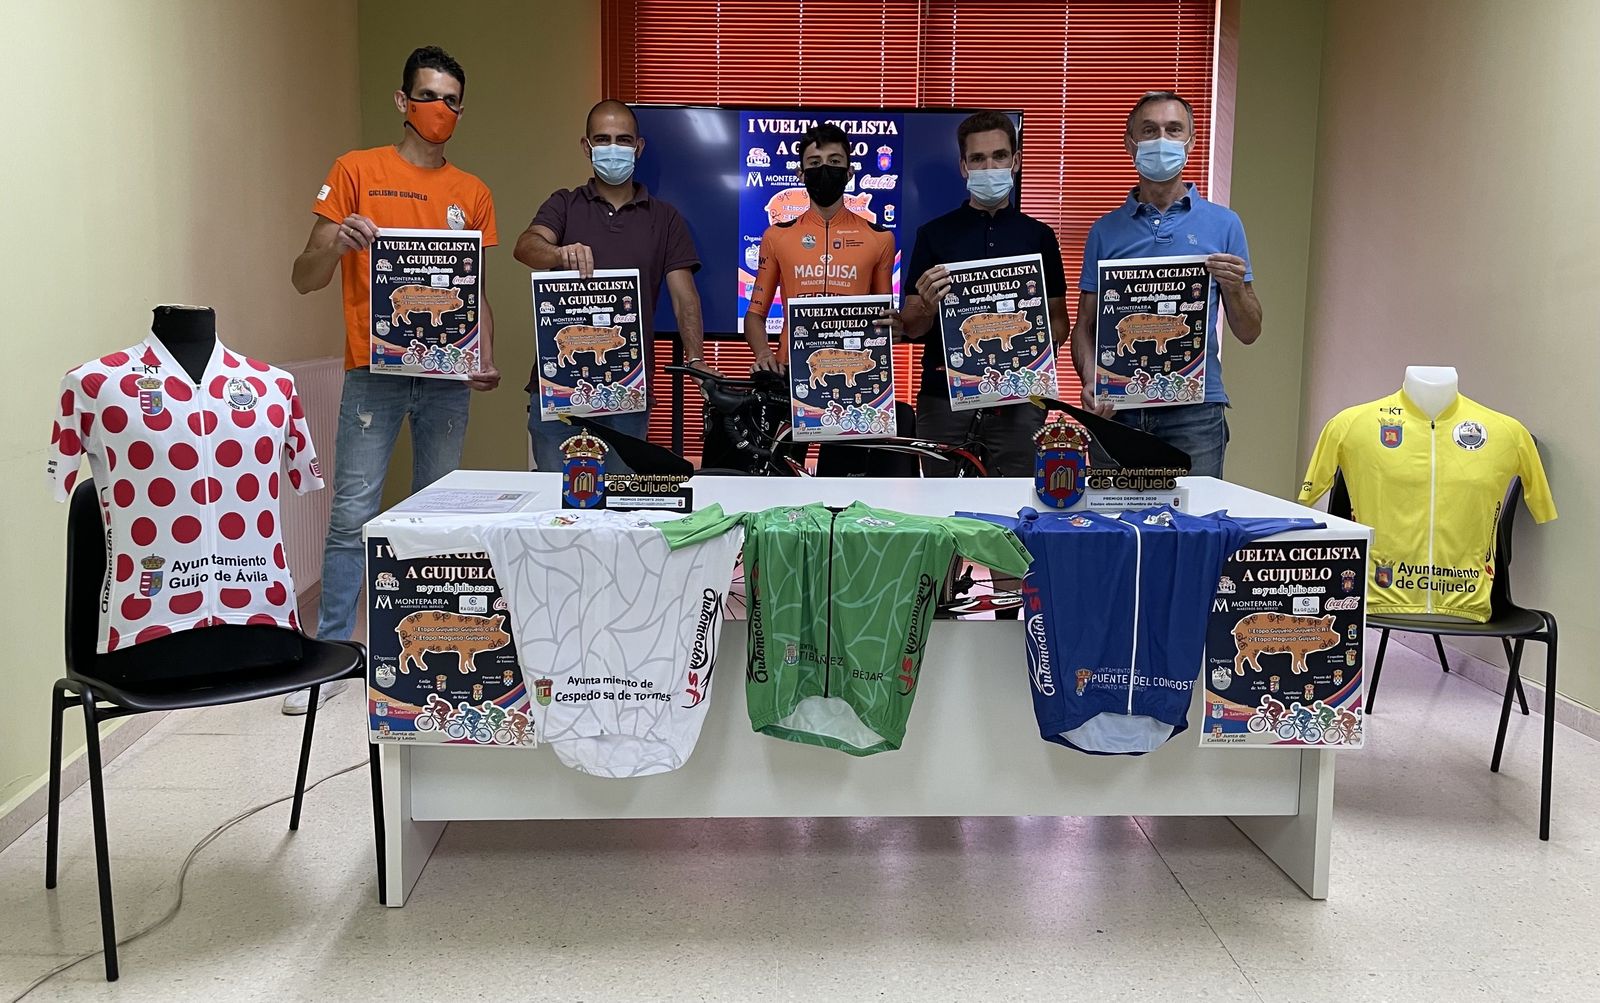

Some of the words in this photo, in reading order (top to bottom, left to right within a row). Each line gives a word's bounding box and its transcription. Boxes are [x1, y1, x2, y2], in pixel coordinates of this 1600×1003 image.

[748, 119, 755, 133] I
[824, 120, 898, 135] CLISTA
[776, 141, 788, 155] A
[400, 191, 428, 201] GUIJUELO
[377, 241, 381, 250] I
[383, 241, 426, 251] VUELTA
[428, 242, 476, 252] CICLISTA
[397, 255, 405, 264] A
[407, 255, 457, 266] GUIJUELO
[795, 264, 857, 280] MAGUISA
[949, 271, 989, 284] VUELTA
[990, 264, 1038, 279] CICLISTA
[1105, 271, 1110, 280] I
[1111, 269, 1154, 280] VUELTA
[1156, 267, 1206, 279] CICLISTA
[539, 284, 543, 293] I
[545, 282, 586, 293] VUELTA
[587, 281, 634, 291] CICLISTA
[962, 287, 970, 296] A
[971, 280, 1021, 294] GUIJUELO
[1124, 284, 1132, 293] A
[1134, 281, 1186, 294] GUIJUELO
[558, 297, 566, 305] A
[567, 294, 617, 306] GUIJUELO
[794, 308, 799, 317] I
[800, 308, 840, 317] VUELTA
[957, 305, 991, 313] MONTEPARRA
[812, 321, 819, 330] A
[821, 319, 868, 330] GUIJUELO
[609, 482, 624, 492] de
[629, 481, 680, 494] Guijuelo
[1091, 477, 1111, 489] de
[1116, 477, 1176, 492] Guijuelo
[375, 545, 383, 558] I
[1289, 547, 1361, 562] CICLISTA
[405, 566, 418, 579] A
[1242, 569, 1254, 582] A
[1257, 568, 1332, 584] GUIJUELO
[1397, 562, 1479, 579] Ayuntamiento
[169, 572, 209, 589] Guijo
[214, 570, 232, 582] de
[235, 568, 268, 583] Ávila
[1395, 577, 1414, 590] de
[1417, 577, 1476, 596] Guijuelo
[641, 679, 653, 689] de
[1091, 674, 1128, 683] PUENTE
[1134, 676, 1151, 686] DEL
[617, 689, 631, 700] de
[634, 692, 671, 702] Tormes
